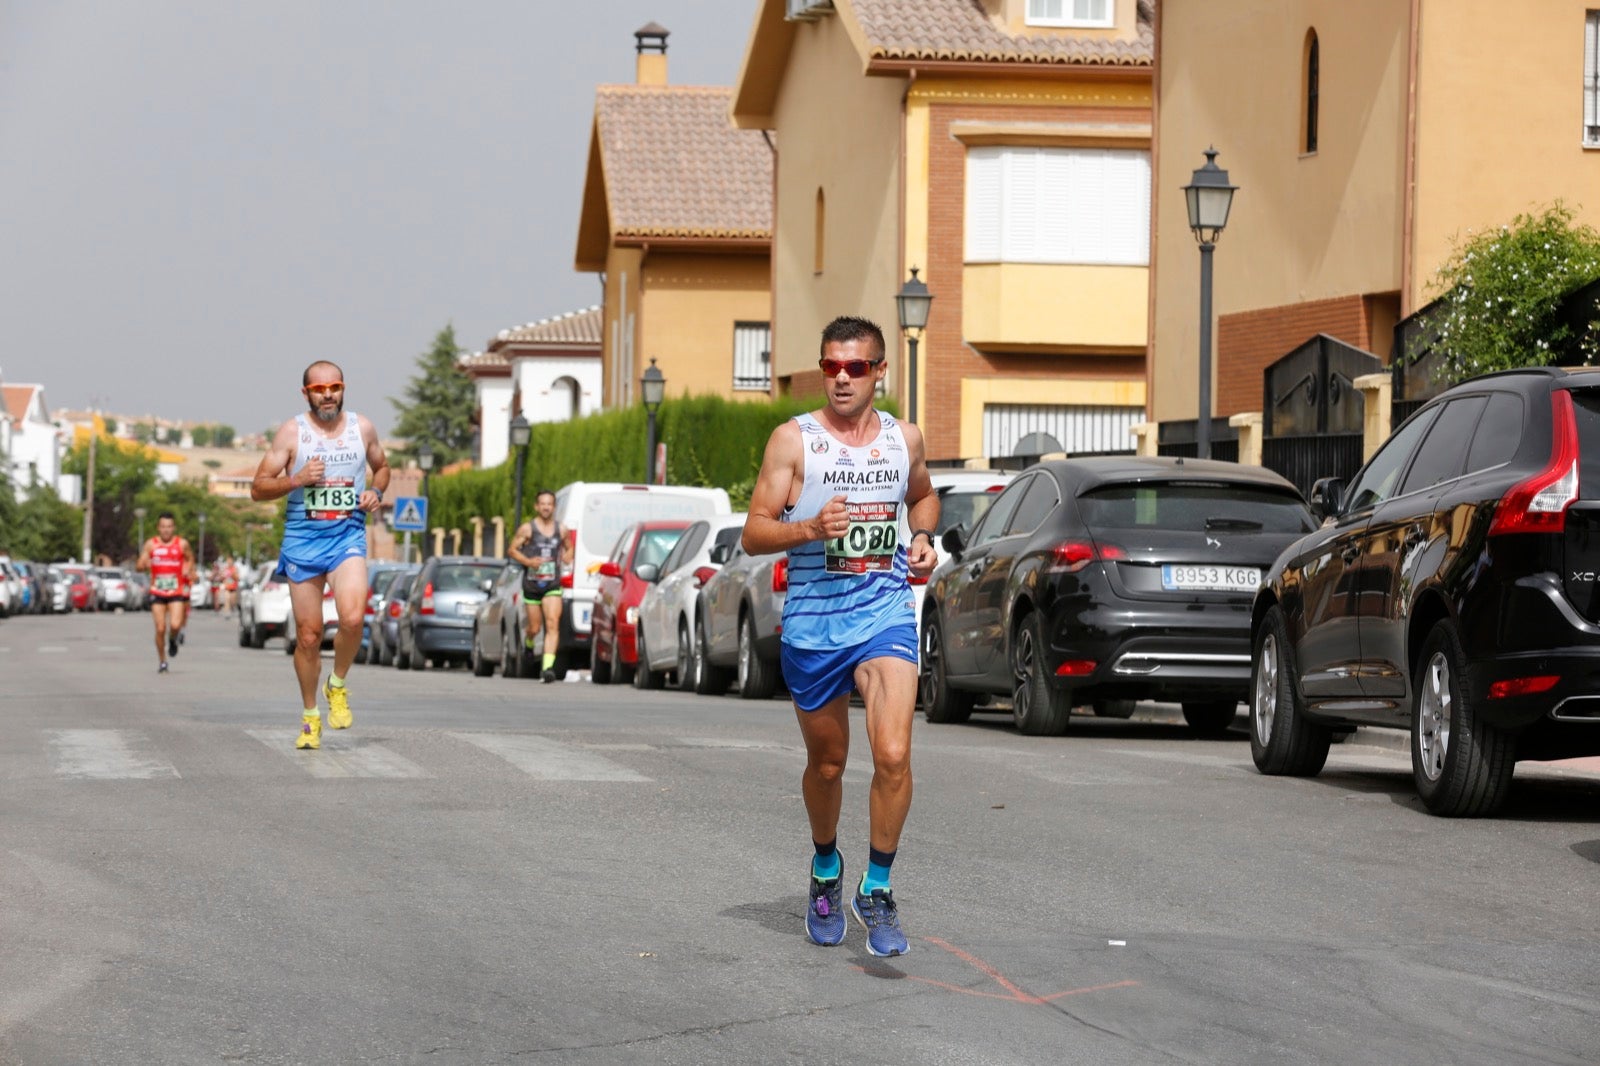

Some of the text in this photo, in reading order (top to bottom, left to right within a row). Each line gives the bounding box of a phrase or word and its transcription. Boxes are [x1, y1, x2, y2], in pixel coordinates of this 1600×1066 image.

[823, 469, 900, 485] MARACENA
[307, 489, 354, 506] 1183
[861, 503, 878, 513] PREMIO
[1175, 567, 1257, 585] 8953 KGG
[1571, 571, 1600, 582] XC
